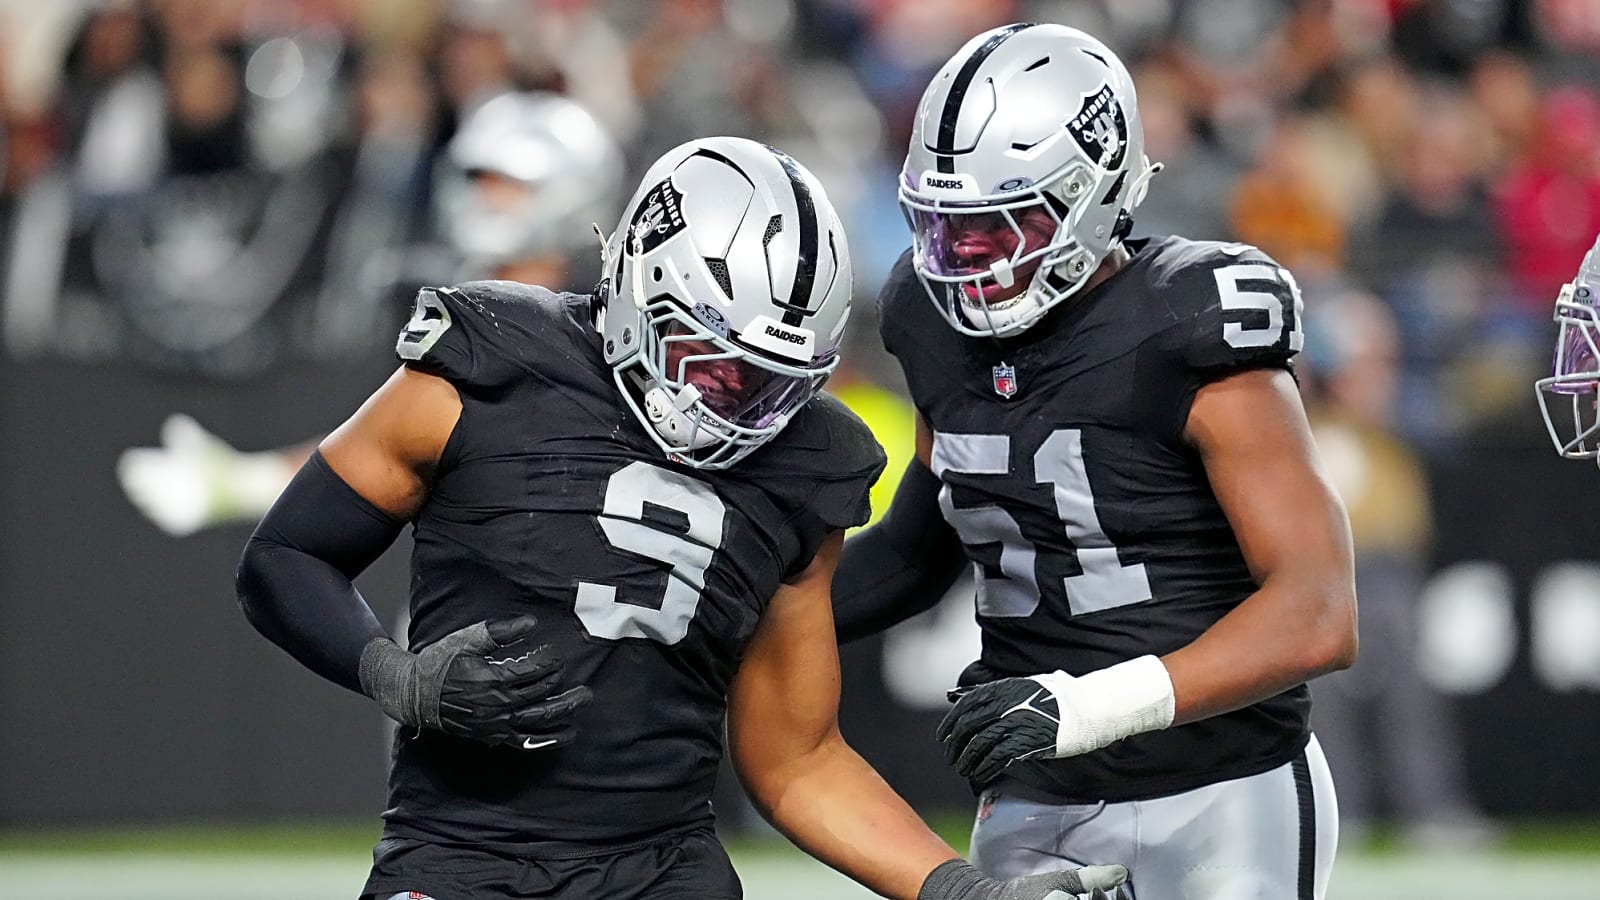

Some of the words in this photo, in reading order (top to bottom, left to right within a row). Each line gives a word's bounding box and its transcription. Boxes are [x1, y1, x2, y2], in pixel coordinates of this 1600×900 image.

[1071, 88, 1111, 131] RAIDERS
[661, 182, 682, 227] RAIDERS
[926, 177, 963, 190] RAIDERS
[396, 287, 452, 360] 9
[764, 325, 807, 345] RAIDERS
[1213, 264, 1304, 351] 51
[931, 429, 1153, 617] 51
[574, 461, 726, 646] 9
